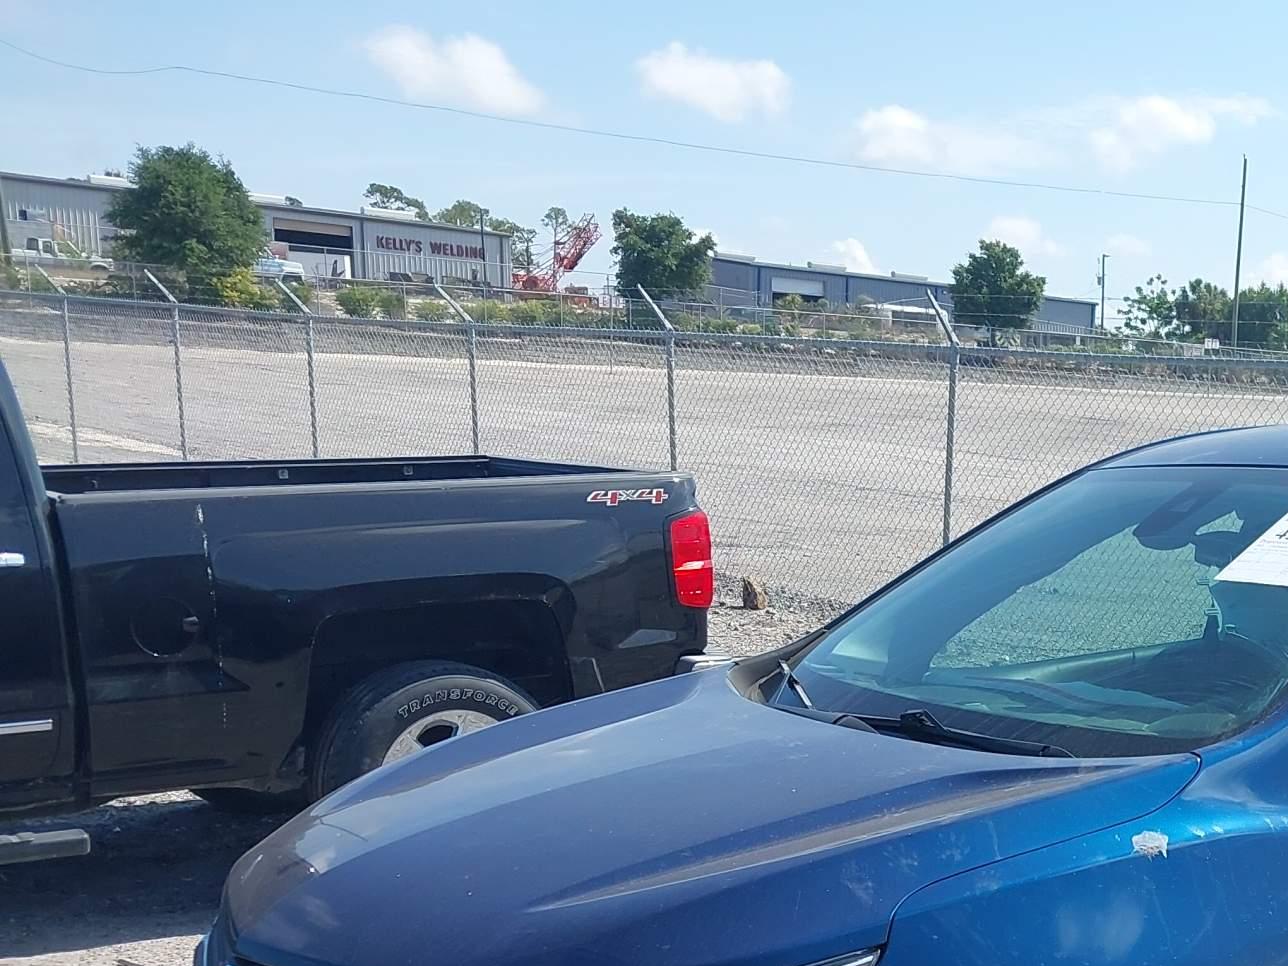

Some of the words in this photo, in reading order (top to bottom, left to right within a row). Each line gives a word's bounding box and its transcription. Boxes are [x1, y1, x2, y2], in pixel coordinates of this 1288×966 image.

[376, 235, 422, 254] KELLY'S
[430, 241, 485, 261] WELDING
[397, 688, 520, 719] TRANSFORCE
